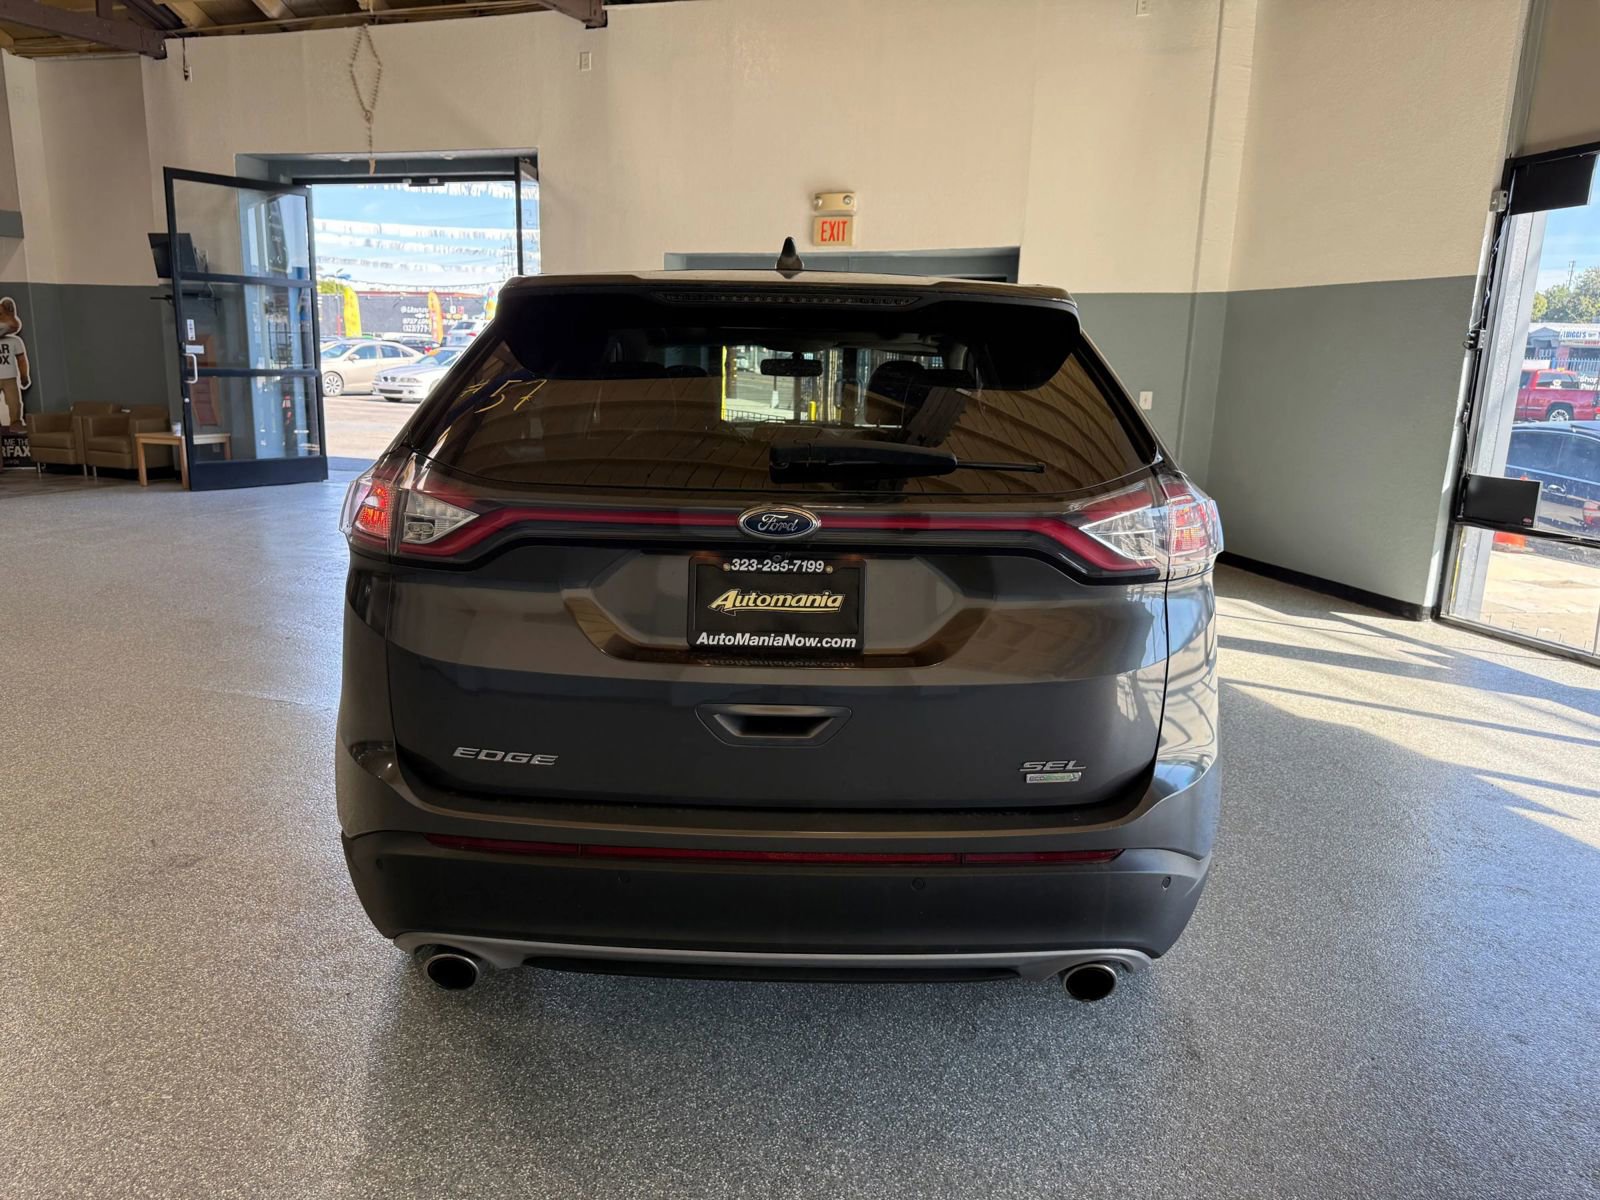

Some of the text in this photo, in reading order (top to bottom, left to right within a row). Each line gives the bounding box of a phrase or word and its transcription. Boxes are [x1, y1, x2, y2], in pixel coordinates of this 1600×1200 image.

[820, 220, 848, 242] EXIT
[757, 514, 800, 532] Ford
[731, 558, 825, 573] 323-285-7199
[708, 588, 845, 614] Automania
[696, 632, 857, 648] AutoManiaNow.com
[452, 746, 559, 766] EDGE
[1019, 760, 1087, 772] SEL
